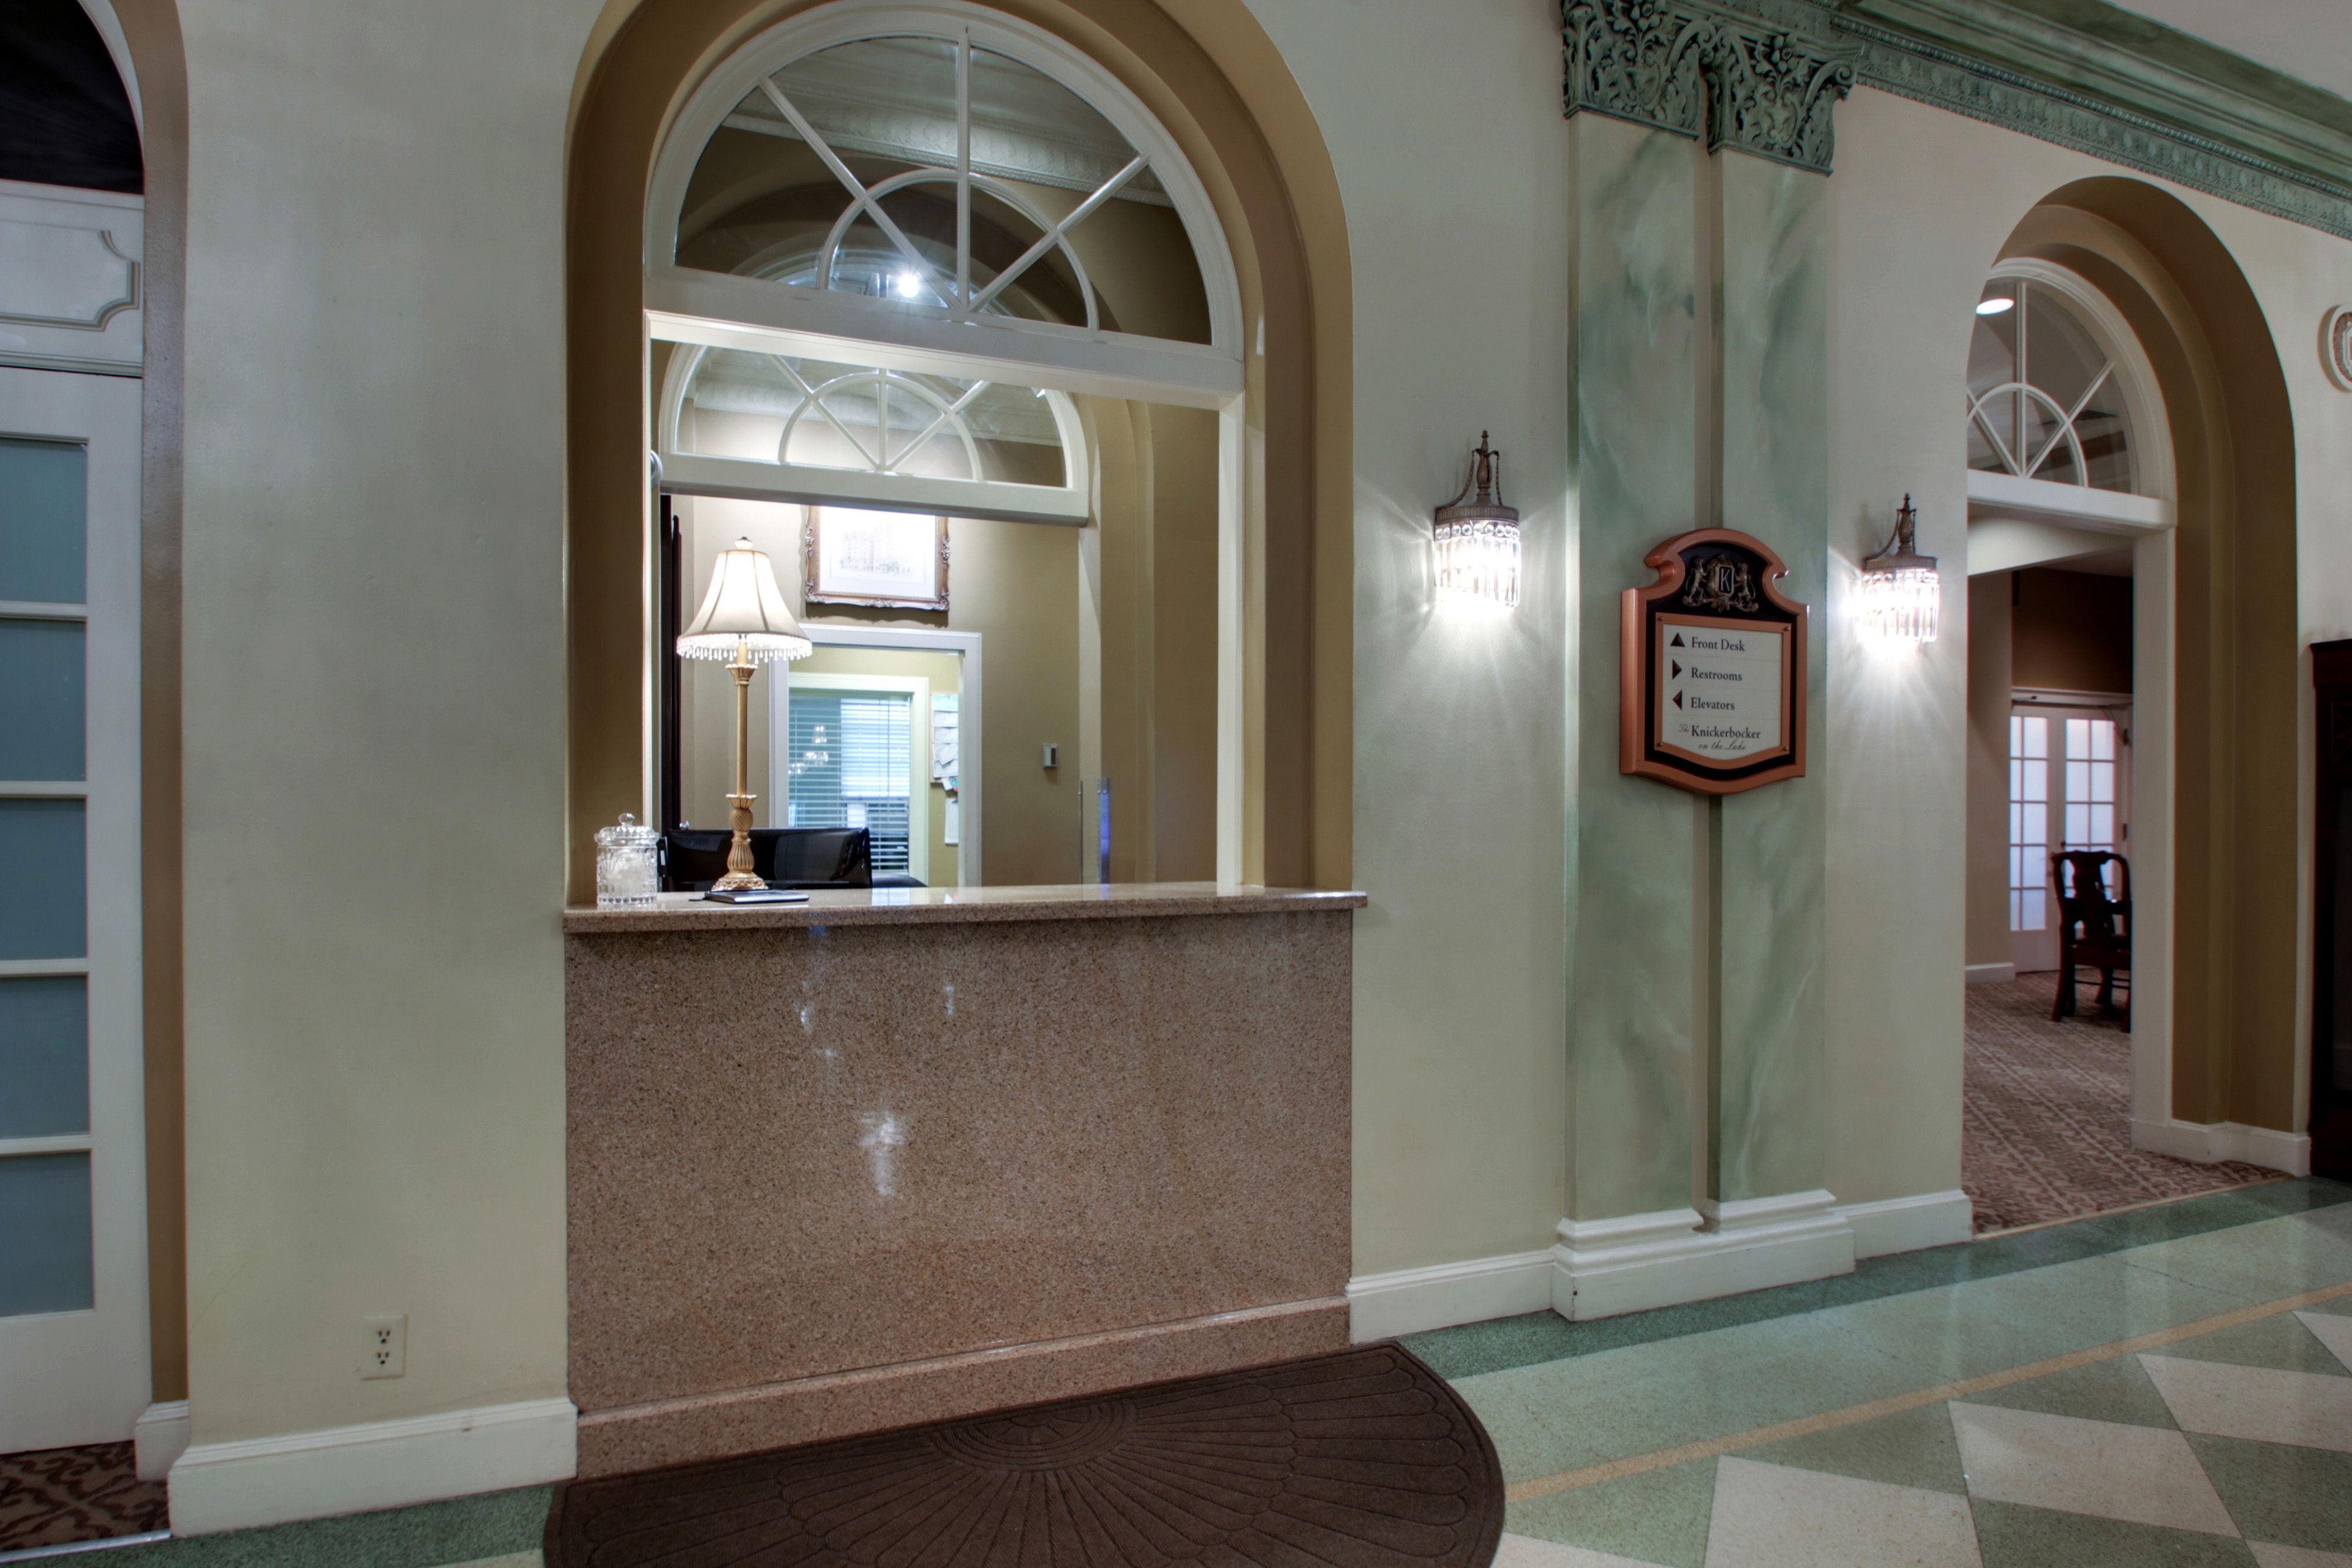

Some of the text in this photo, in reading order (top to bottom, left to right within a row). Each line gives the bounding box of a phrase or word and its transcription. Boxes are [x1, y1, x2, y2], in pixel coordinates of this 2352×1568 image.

[1721, 568, 1730, 592] K
[1691, 636, 1745, 651] Front Desk
[1691, 666, 1742, 681] Restrooms
[1691, 697, 1735, 710] Elevators
[1691, 725, 1761, 739] Knickerbocker
[1711, 740, 1723, 750] the
[1724, 739, 1746, 751] Lake
